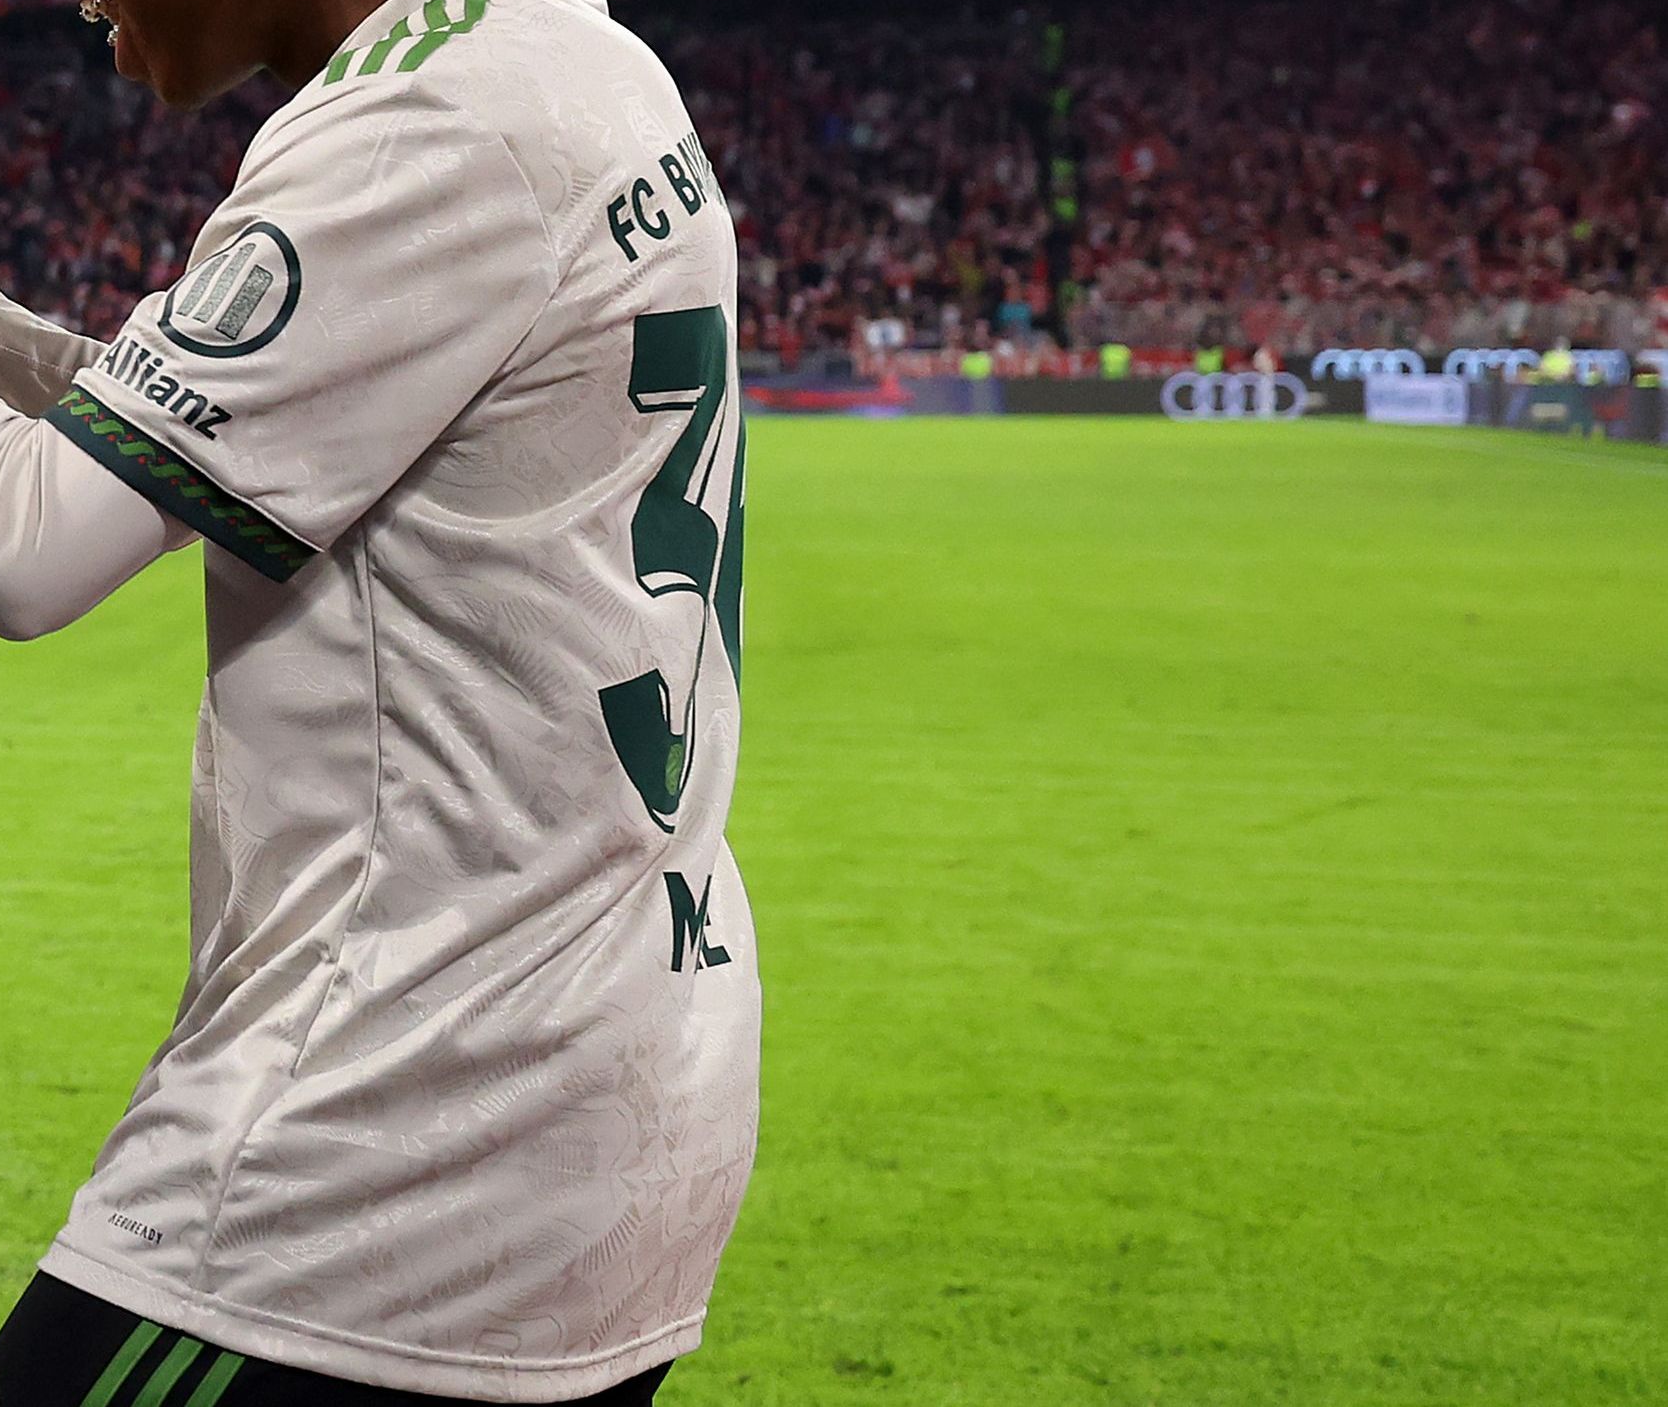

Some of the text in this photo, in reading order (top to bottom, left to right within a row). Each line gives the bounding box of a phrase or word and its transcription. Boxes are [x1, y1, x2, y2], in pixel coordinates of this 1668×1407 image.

[607, 177, 671, 263] FC
[98, 335, 232, 441] Allianz
[598, 303, 745, 834] 3
